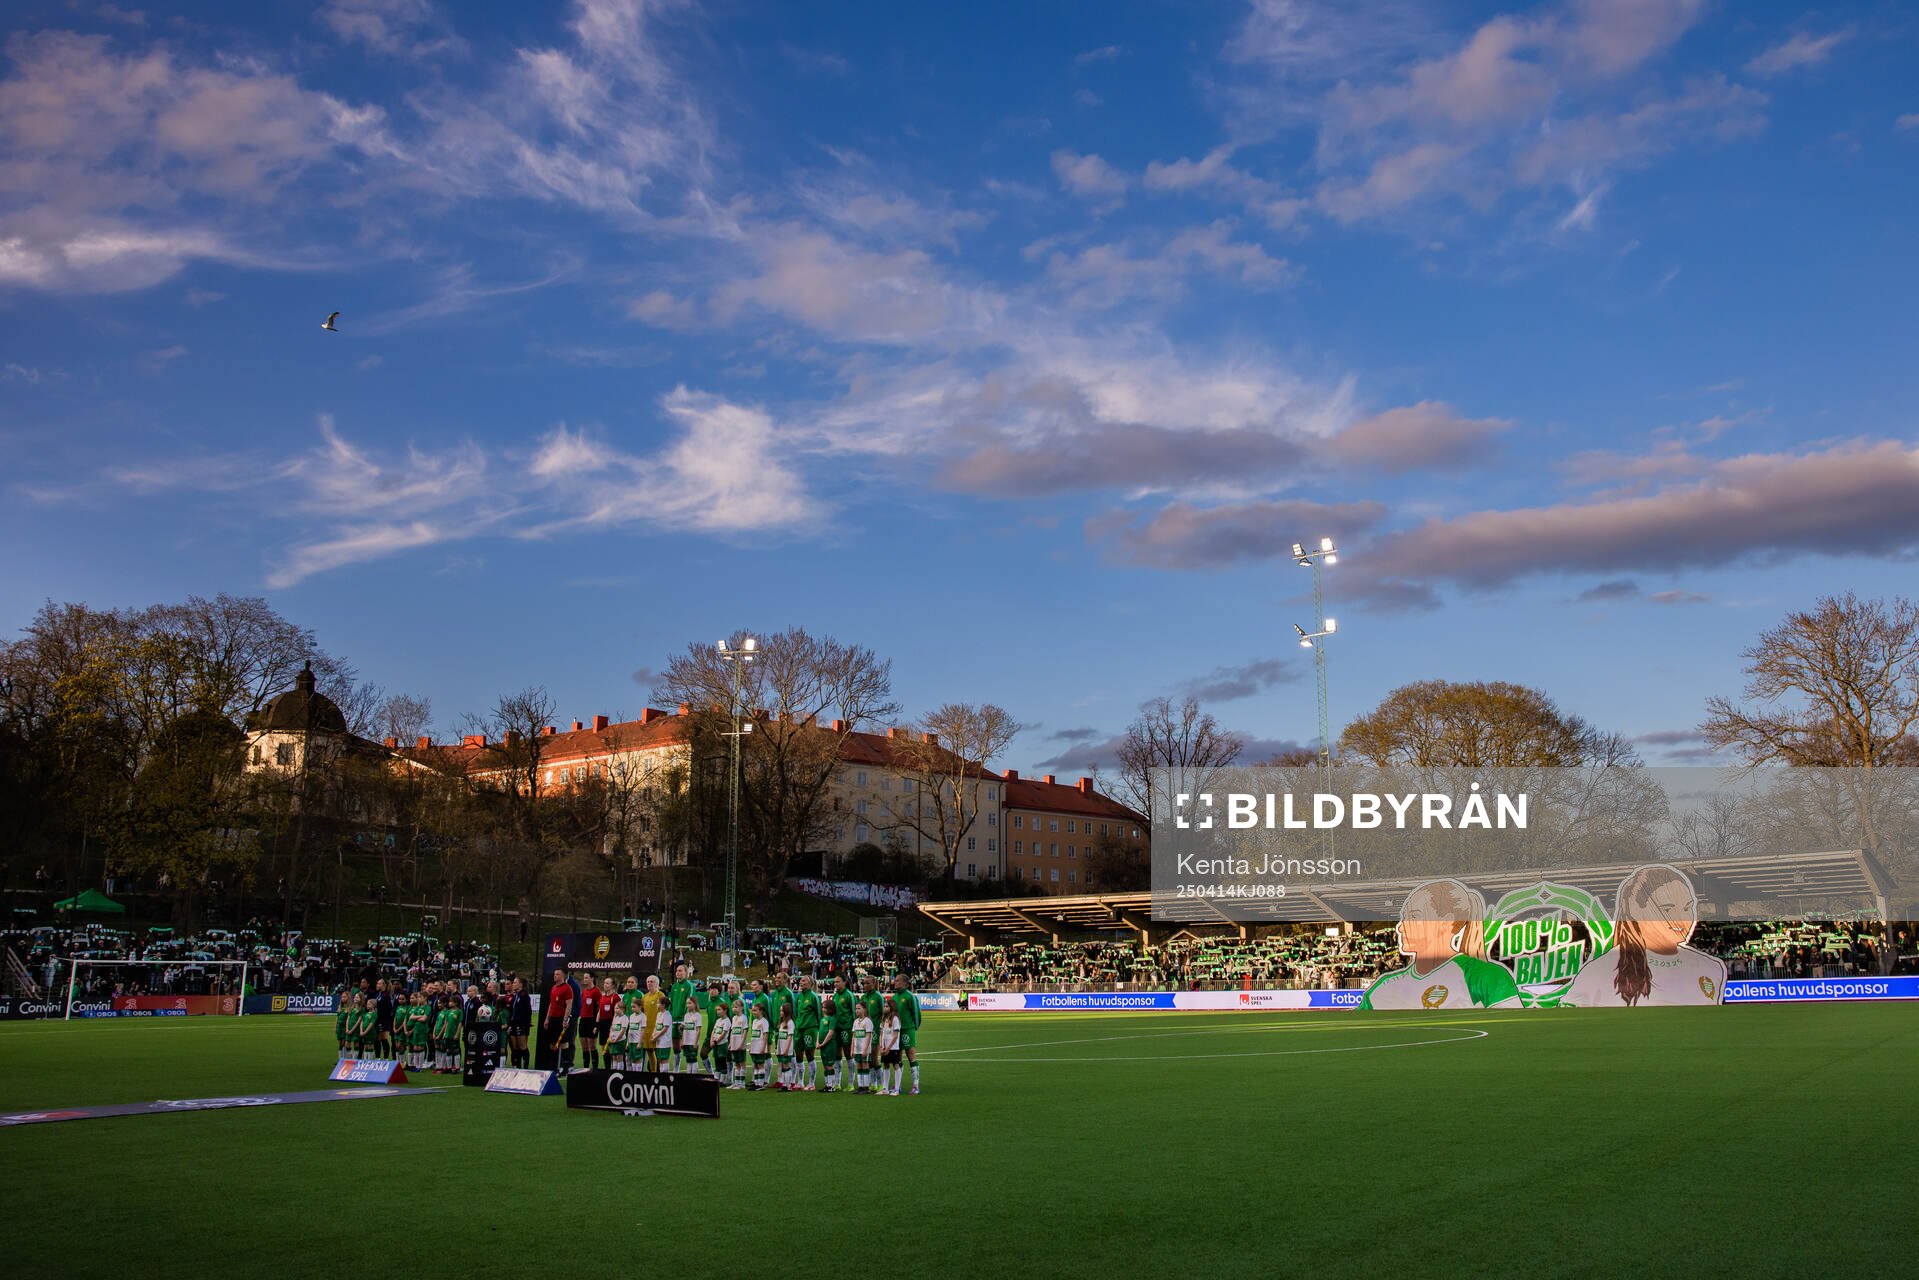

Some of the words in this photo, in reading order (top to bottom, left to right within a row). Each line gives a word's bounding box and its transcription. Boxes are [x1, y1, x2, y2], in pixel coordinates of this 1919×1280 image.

[1502, 911, 1570, 958] 100%
[1516, 943, 1583, 986] BAJEN
[1778, 982, 1889, 998] huvudsponsor
[19, 1001, 62, 1014] Convini
[71, 1000, 111, 1013] Convini
[287, 995, 333, 1007] PROJOB
[921, 996, 937, 1006] Heja
[1041, 996, 1087, 1006] Fotbollens
[1088, 995, 1156, 1008] huvudsponsor
[355, 1060, 390, 1072] SVENSKA
[348, 1071, 368, 1081] SPEL
[606, 1072, 675, 1106] Convini
